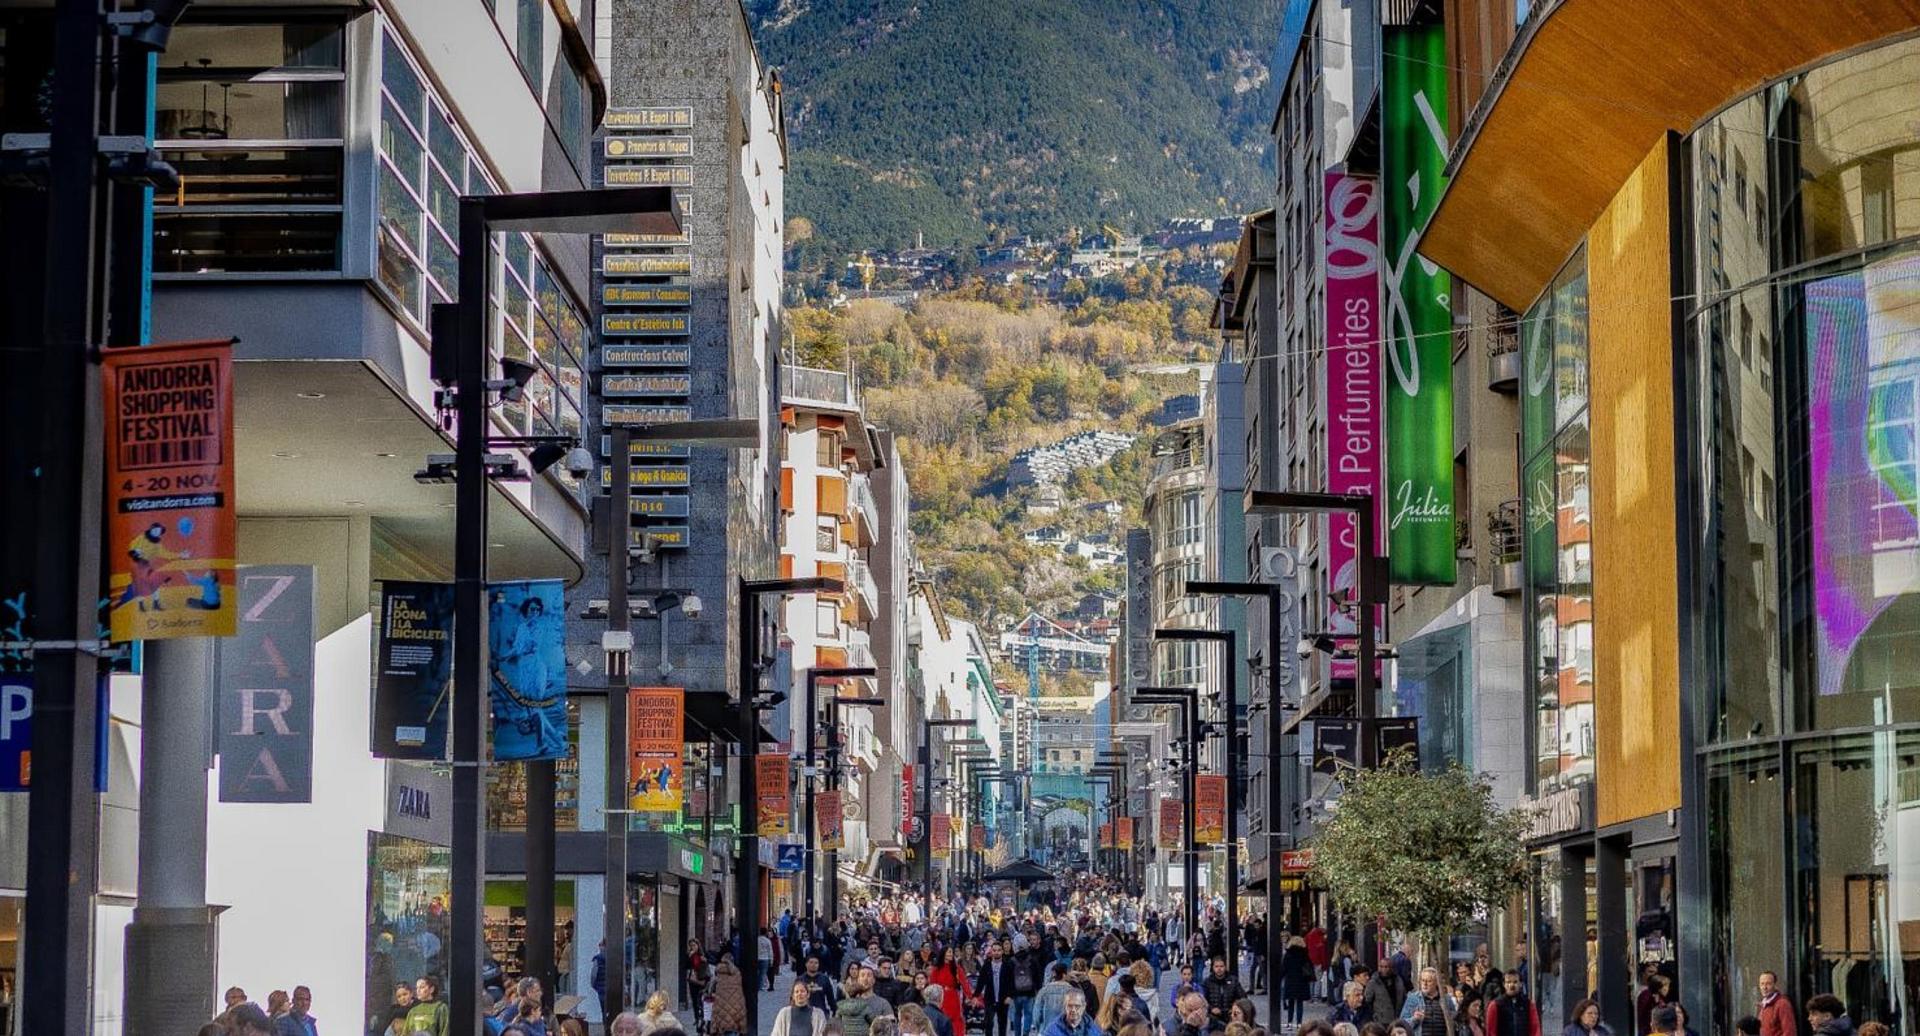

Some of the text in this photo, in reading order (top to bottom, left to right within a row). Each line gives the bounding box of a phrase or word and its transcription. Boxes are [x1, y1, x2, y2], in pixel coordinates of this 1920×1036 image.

[123, 363, 213, 392] ANDORRA
[1339, 298, 1371, 473] Perfumeries
[122, 388, 214, 416] SHOPPING
[123, 413, 214, 442] FESTIVAL
[122, 479, 133, 492] 4
[149, 476, 171, 491] 20
[1391, 479, 1451, 530] Júlia
[393, 611, 428, 621] DONA
[394, 600, 408, 610] LA
[391, 630, 449, 640] BICICLETA
[399, 620, 412, 629] LA
[229, 574, 304, 793] ZARA
[1, 685, 33, 740] P
[638, 708, 675, 717] SHOPPING
[639, 697, 675, 707] ANDORRA
[638, 718, 674, 728] FESTIVAL
[398, 784, 430, 819] ZARA
